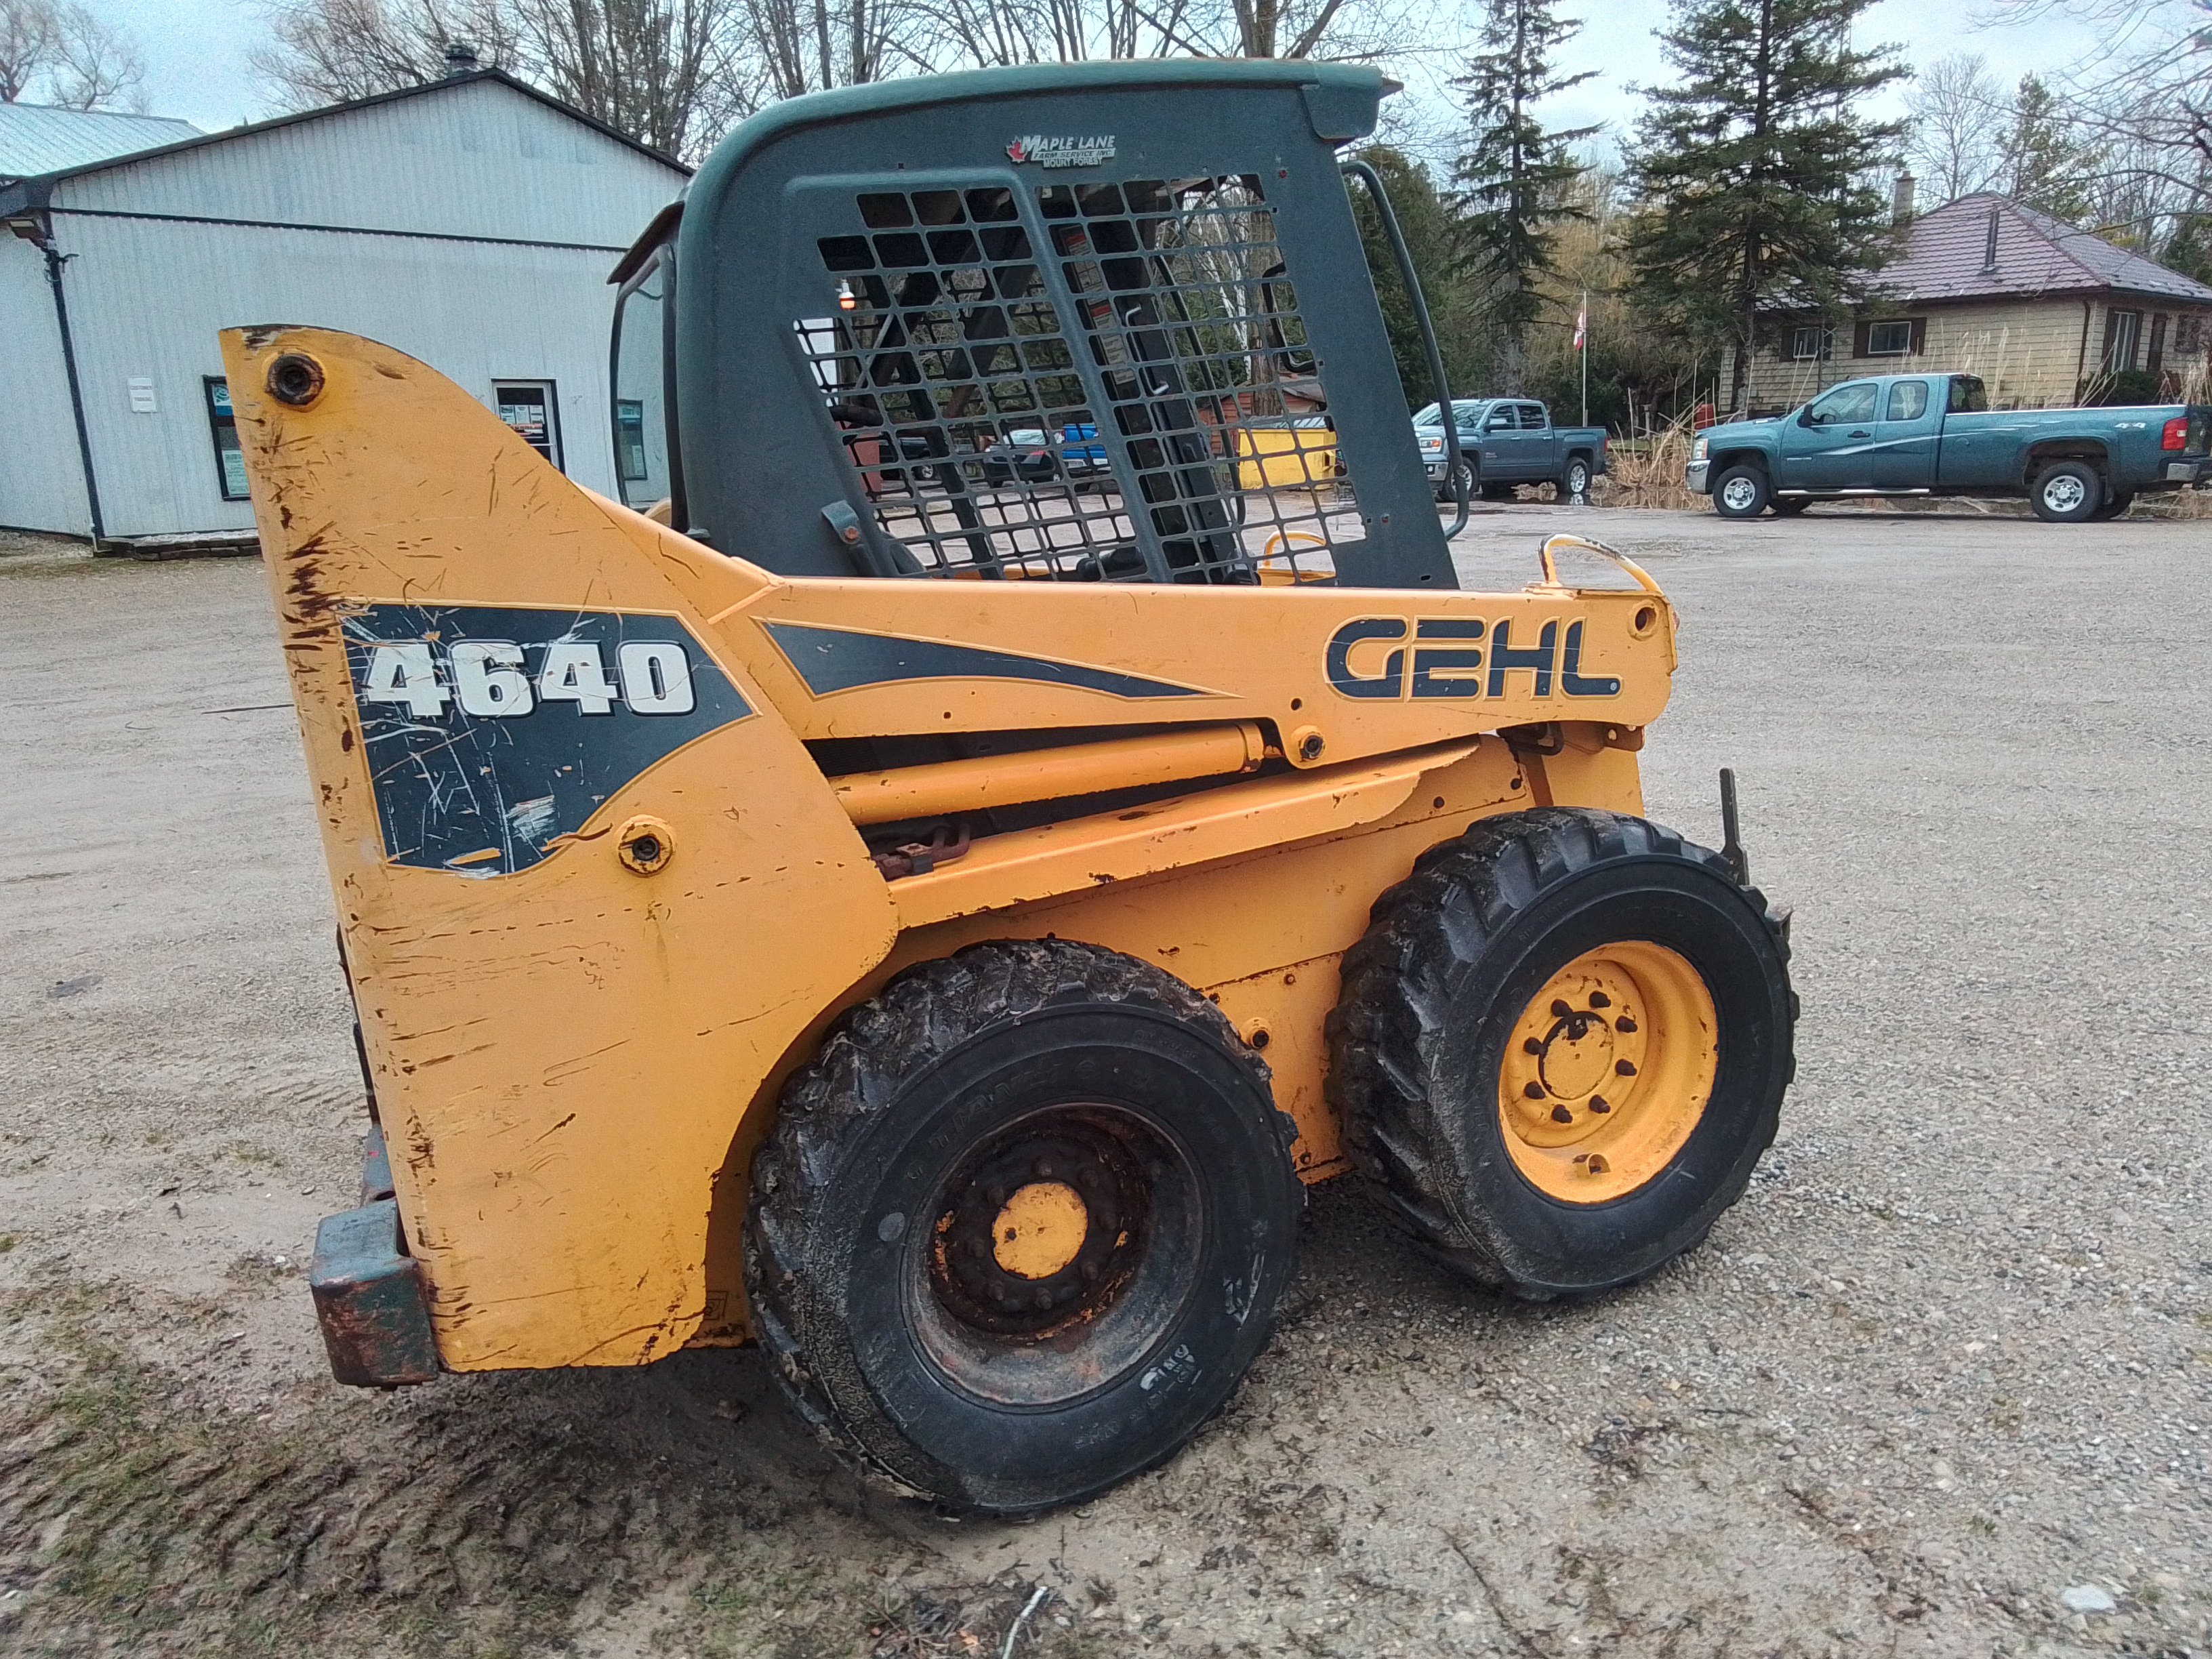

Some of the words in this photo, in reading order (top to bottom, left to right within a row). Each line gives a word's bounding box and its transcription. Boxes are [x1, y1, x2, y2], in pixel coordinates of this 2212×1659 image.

[1020, 135, 1074, 152] MAPLE
[1078, 135, 1115, 149] LANE
[1044, 158, 1071, 167] MOUNT
[1073, 157, 1102, 167] FOREST
[366, 640, 697, 718] 4640
[1325, 616, 1622, 699] GEHL
